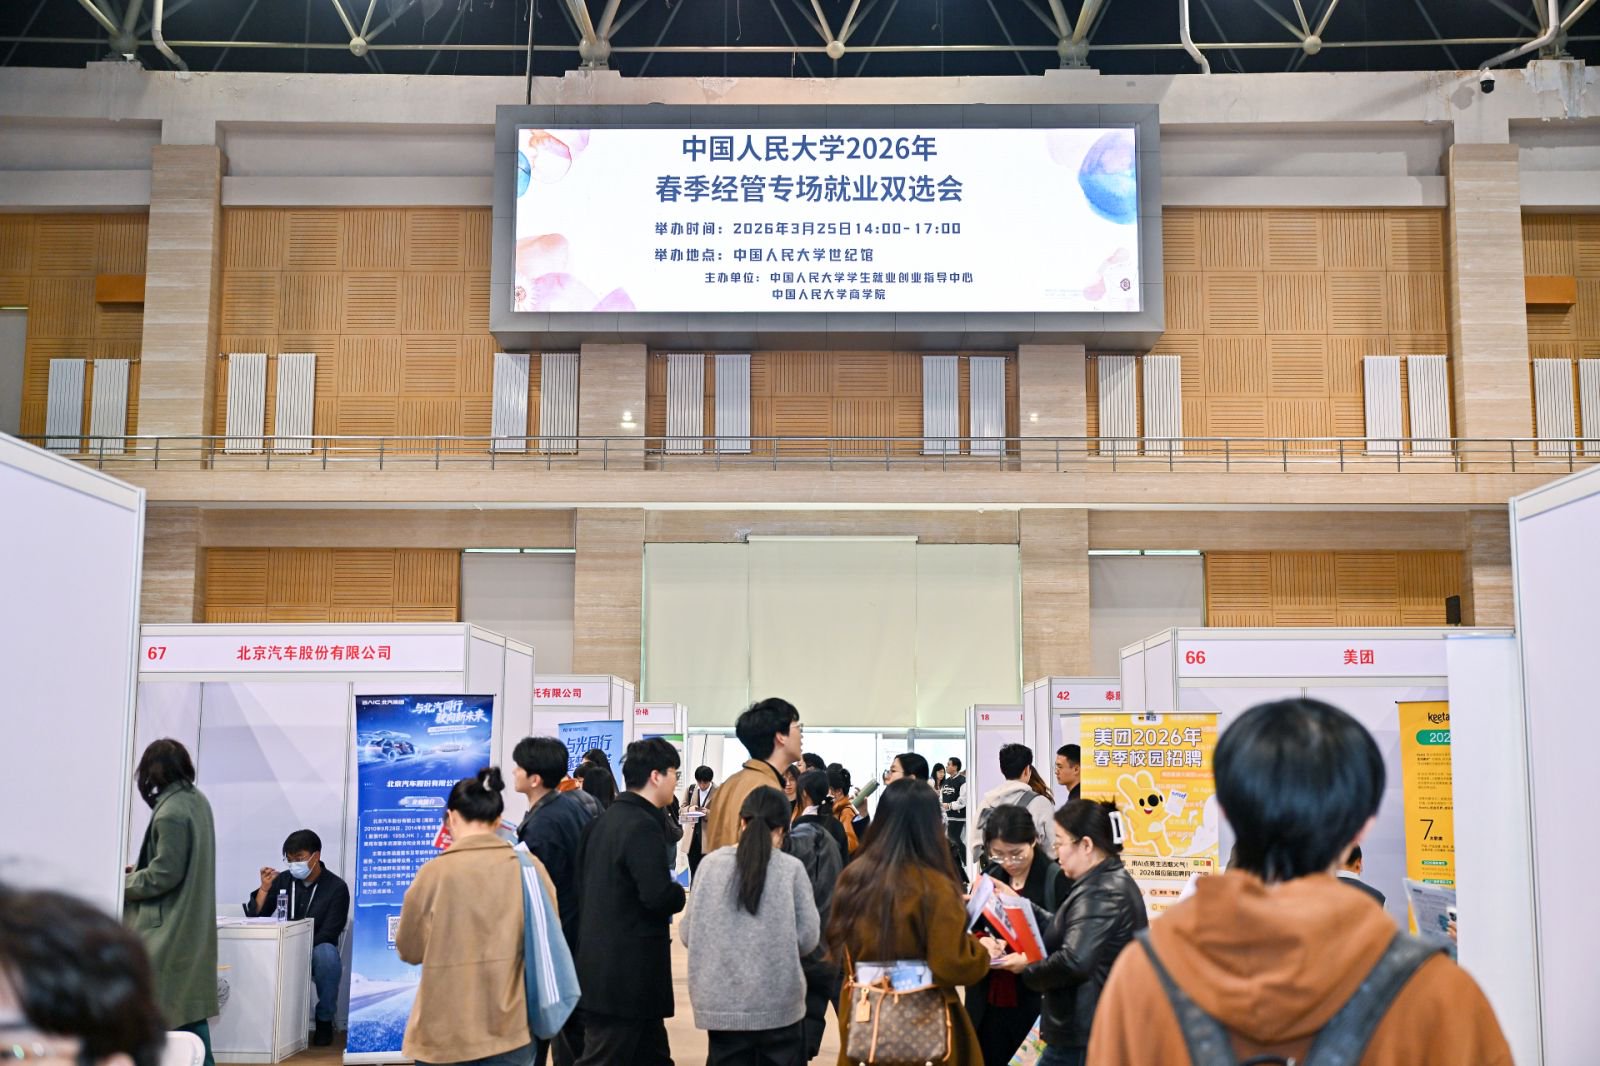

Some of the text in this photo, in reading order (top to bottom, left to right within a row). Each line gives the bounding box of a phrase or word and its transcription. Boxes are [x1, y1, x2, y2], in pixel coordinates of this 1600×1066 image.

[682, 134, 938, 163] 中国人民大学2026年
[655, 174, 963, 203] 春季经管专场就业双选会
[655, 247, 874, 262] 举办地点：中国人民大学世纪馆
[772, 288, 886, 300] 中国人民大学商学院
[147, 645, 167, 661] 67
[236, 645, 392, 661] 北京汽车股份有限公司
[1185, 650, 1207, 665] 66
[1343, 649, 1375, 665] 美团
[1056, 691, 1070, 701] 42
[567, 734, 613, 754] 与光同行
[1094, 727, 1203, 747] 美团2026年
[1094, 749, 1203, 768] 春季校园招聘
[1420, 819, 1434, 840] 7
